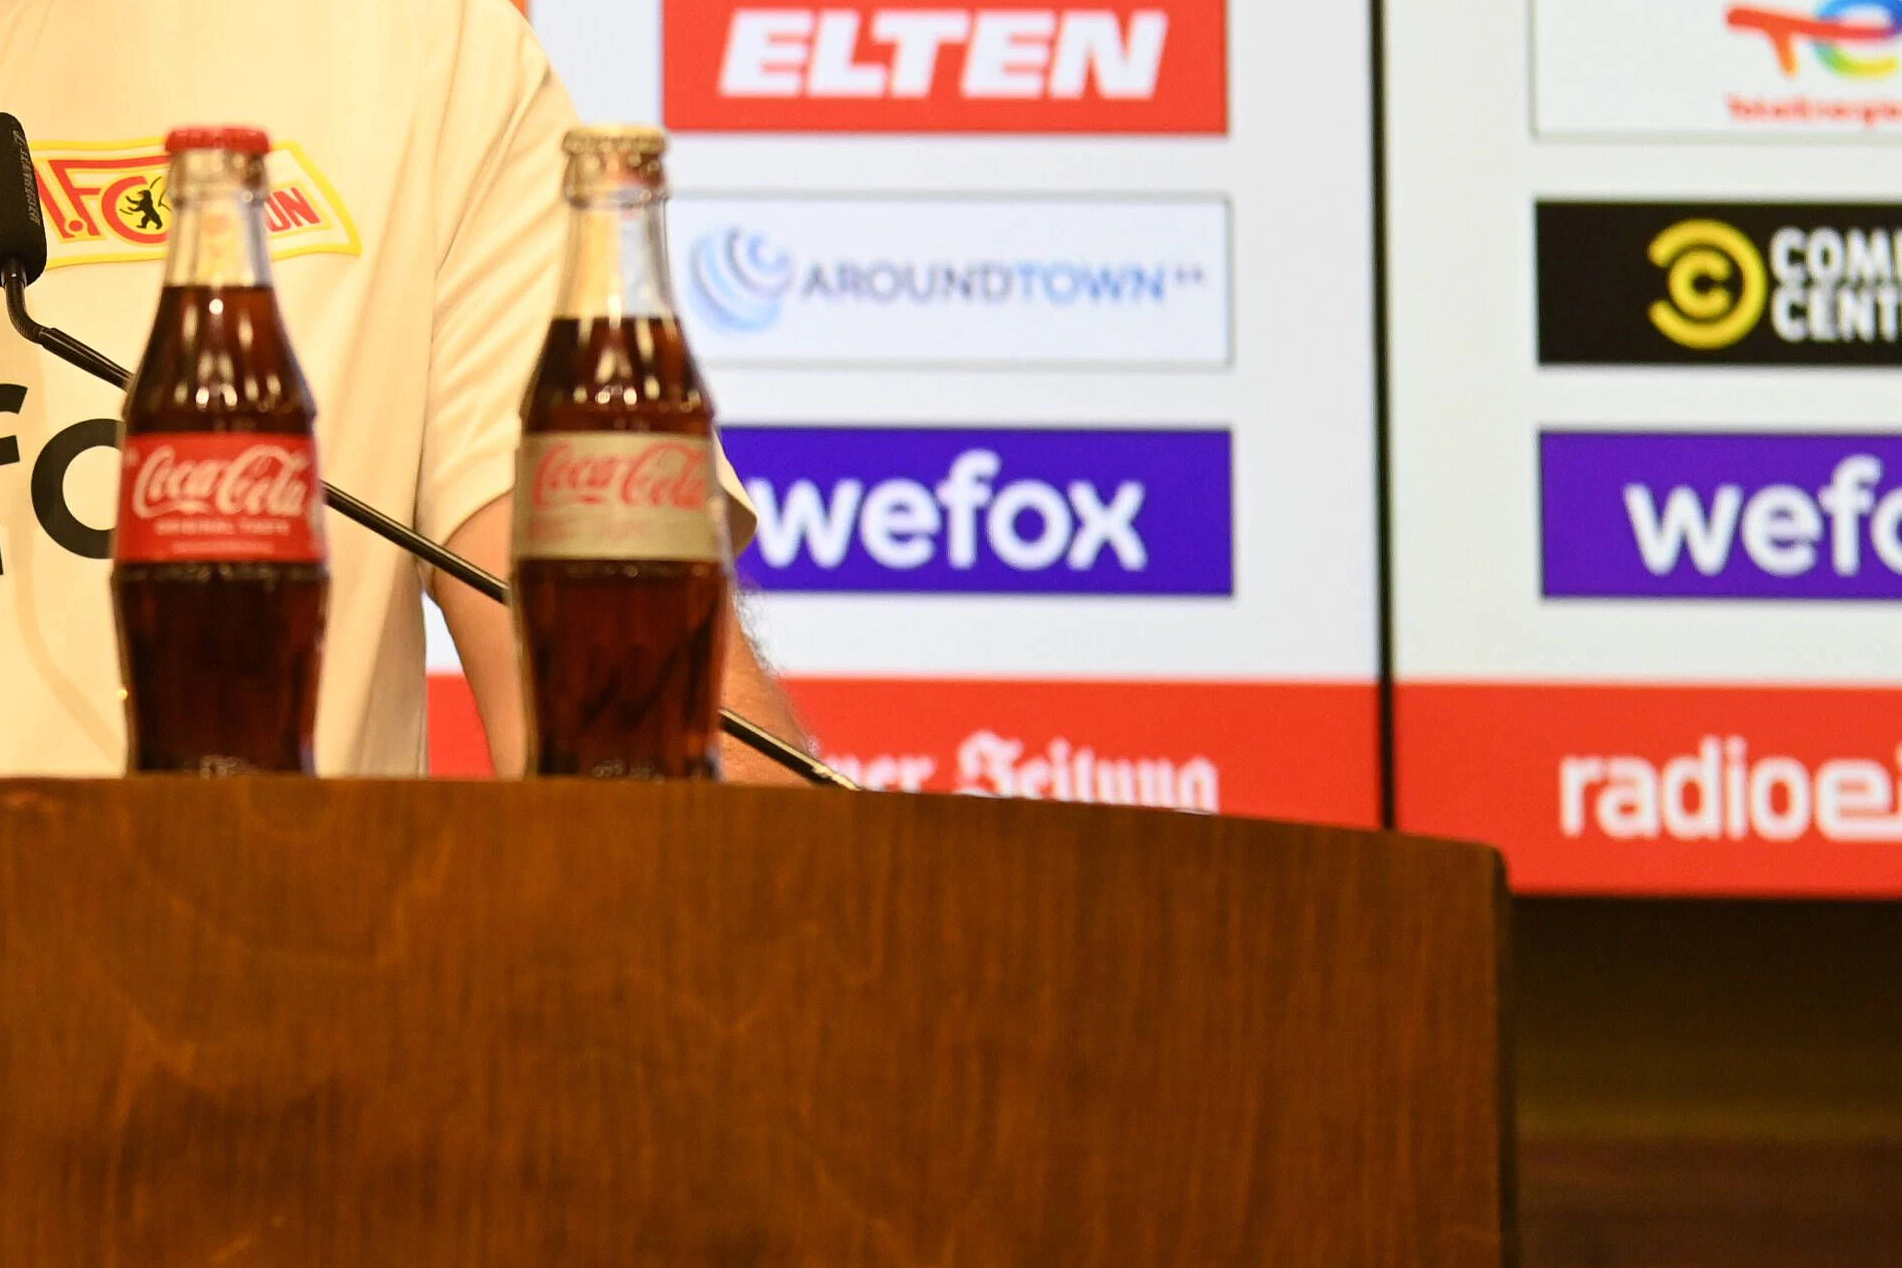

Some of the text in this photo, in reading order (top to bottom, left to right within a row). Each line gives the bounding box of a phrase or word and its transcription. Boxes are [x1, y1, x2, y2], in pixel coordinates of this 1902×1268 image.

[719, 9, 1167, 99] ELTEN
[804, 262, 1165, 303] AROUNDTOWN
[1770, 226, 1902, 283] COM
[747, 449, 1146, 571] wefox
[1560, 734, 1902, 841] radioe
